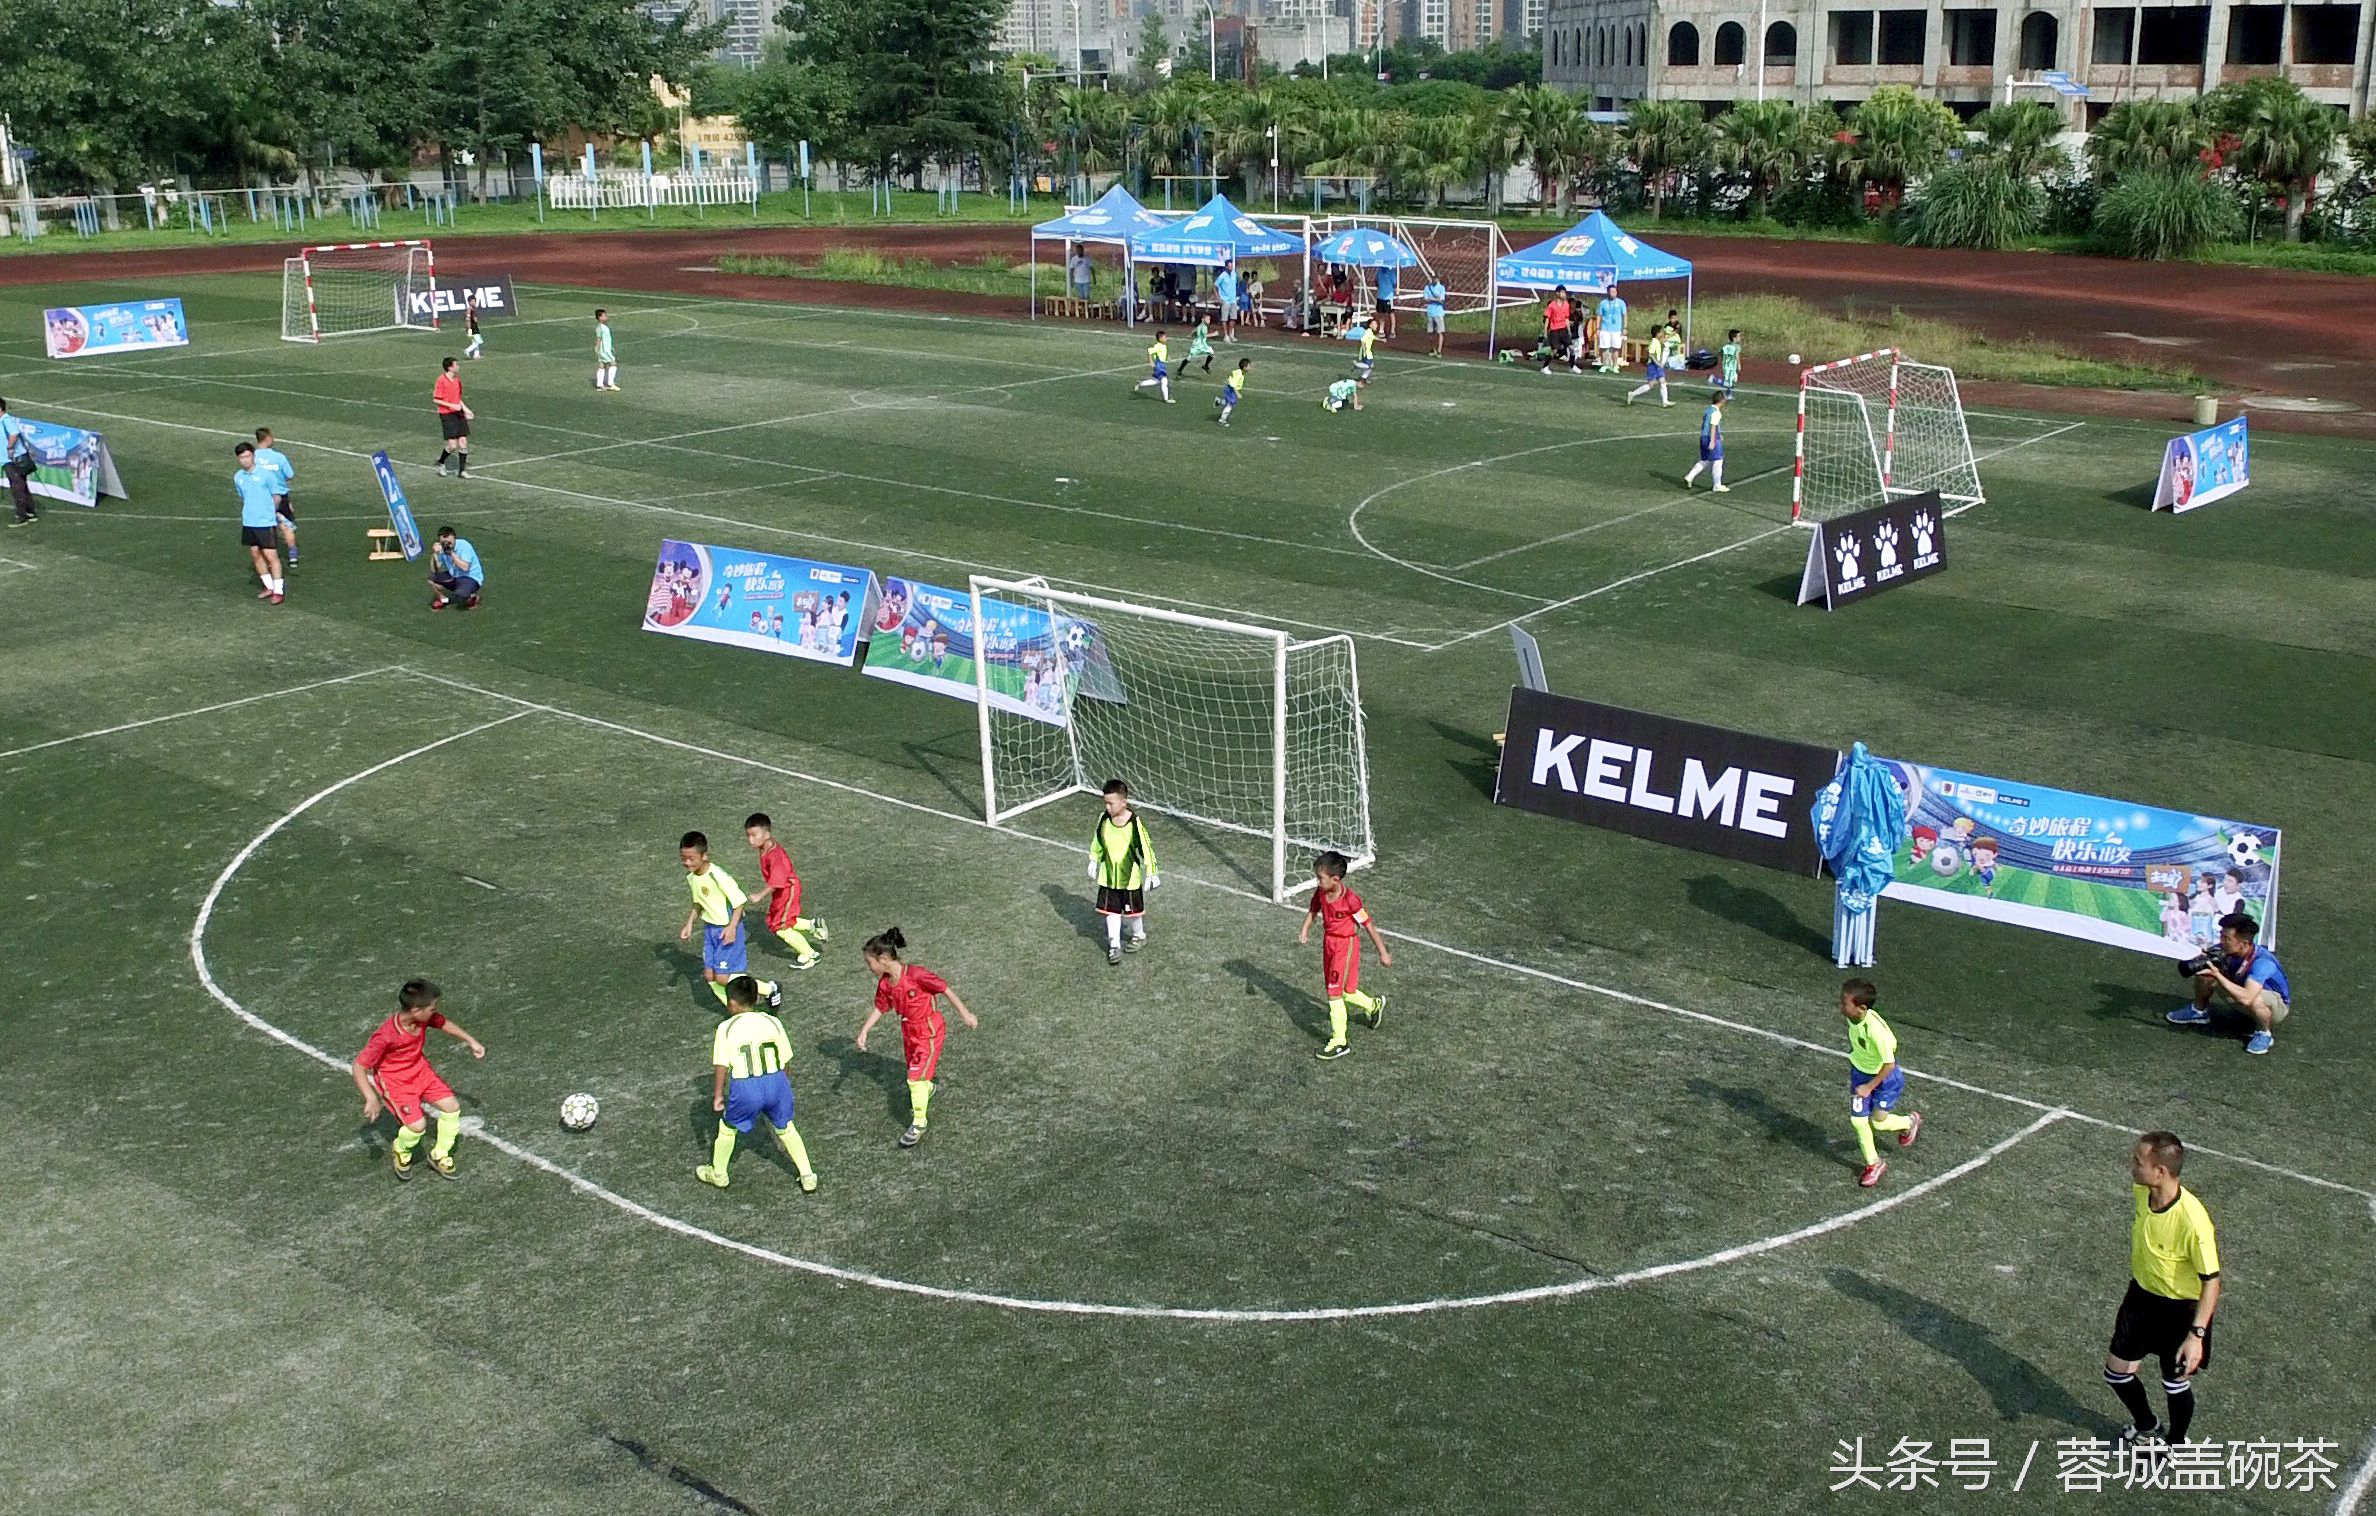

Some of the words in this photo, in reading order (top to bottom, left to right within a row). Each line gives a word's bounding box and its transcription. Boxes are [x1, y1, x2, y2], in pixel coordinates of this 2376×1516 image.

[411, 286, 504, 313] KELME
[1838, 577, 1866, 595] KELME
[1531, 728, 1795, 839] KELME
[2008, 816, 2093, 837] 奇妙旅程
[2051, 834, 2133, 864] 快乐出发
[739, 1042, 781, 1077] 10
